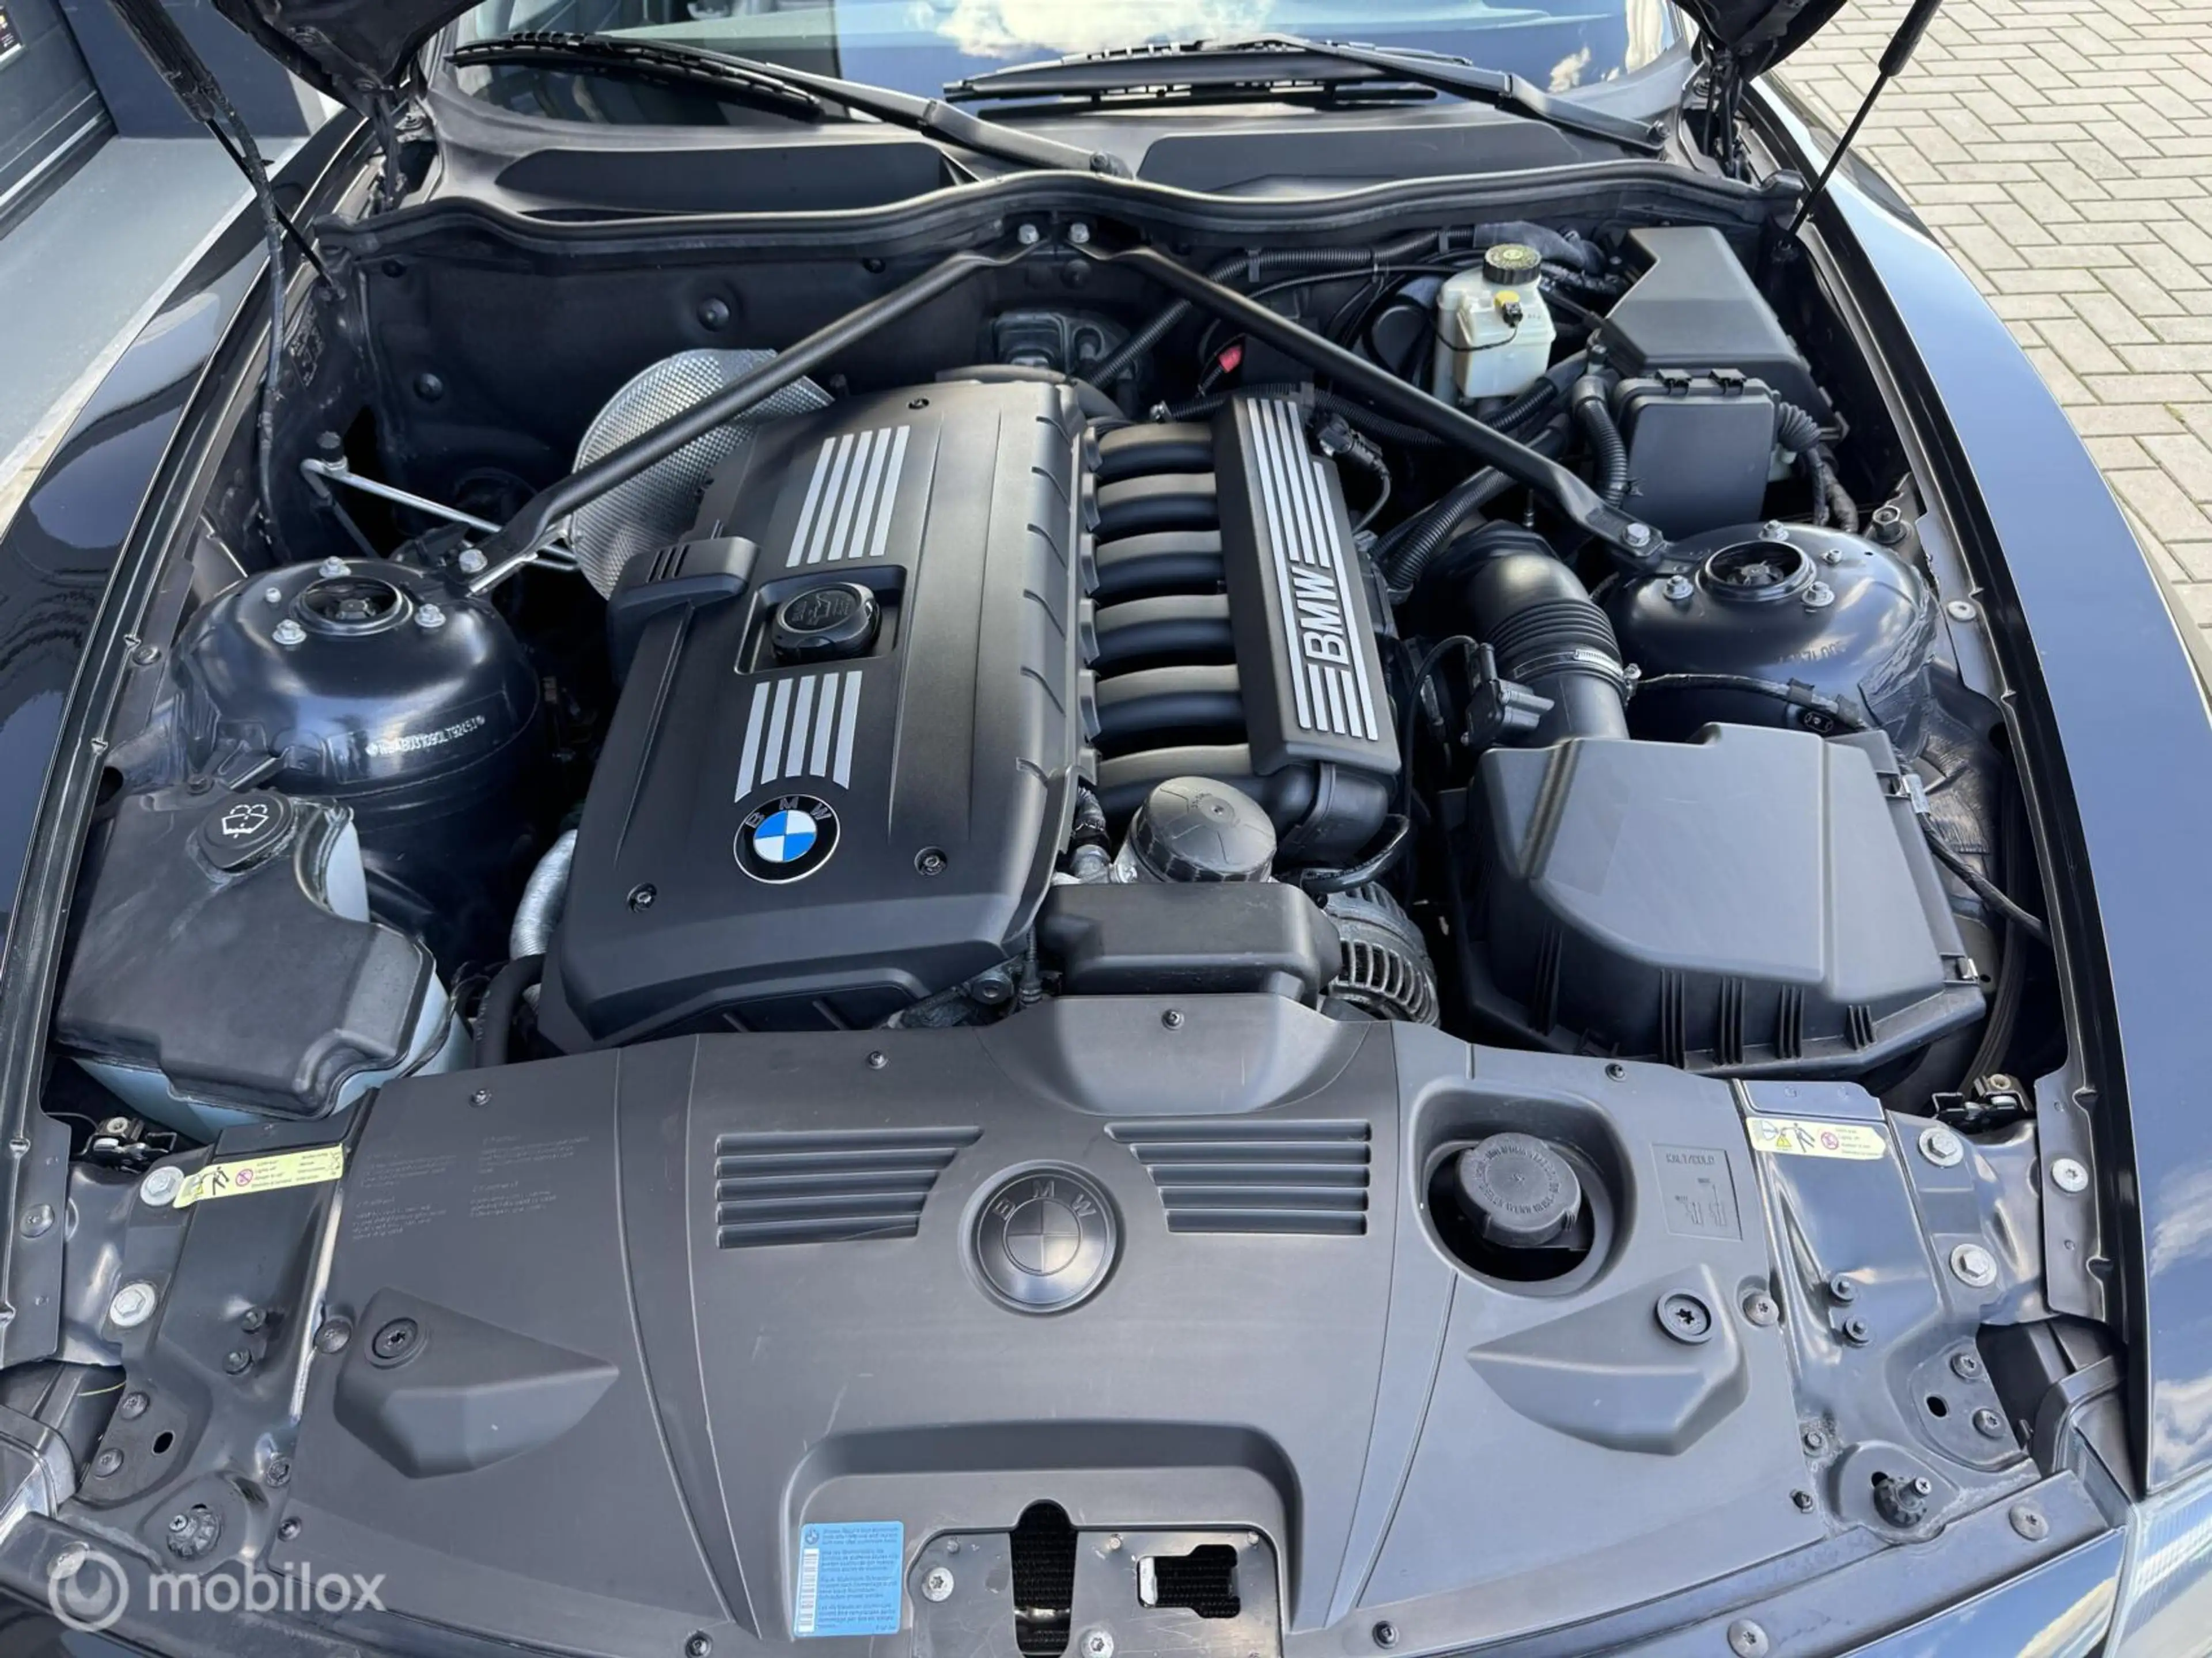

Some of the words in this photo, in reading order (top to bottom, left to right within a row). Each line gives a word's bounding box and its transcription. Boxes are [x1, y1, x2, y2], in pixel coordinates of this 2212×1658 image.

[1291, 566, 1349, 665] BMW
[745, 796, 832, 829] BMW
[993, 1180, 1097, 1220] BMW
